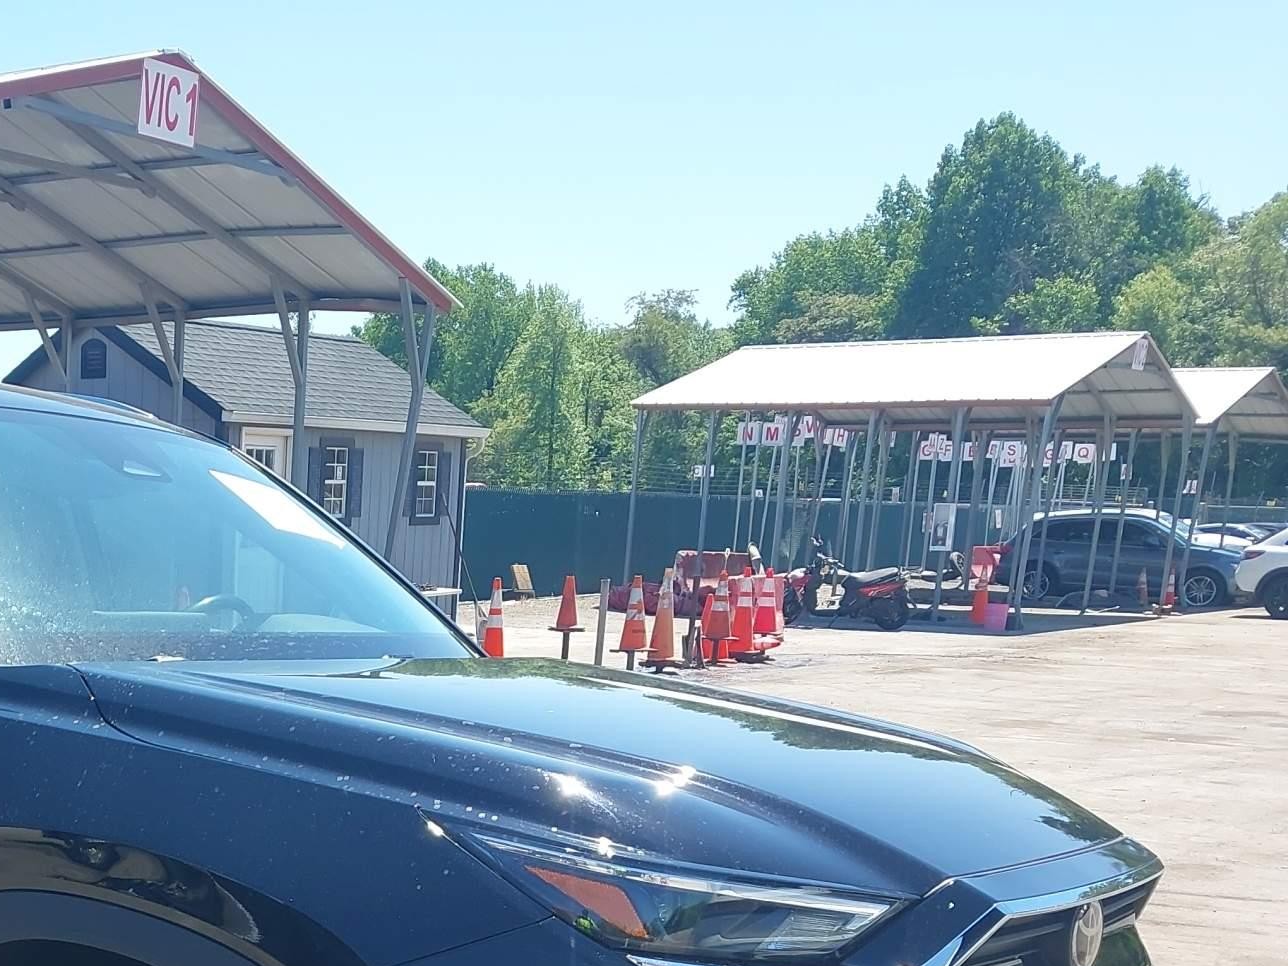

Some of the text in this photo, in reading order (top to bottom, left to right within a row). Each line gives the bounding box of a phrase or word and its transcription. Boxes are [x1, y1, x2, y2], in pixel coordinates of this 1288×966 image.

[144, 68, 197, 137] VIC 1
[742, 426, 754, 441] N
[766, 426, 779, 441] M
[1007, 444, 1017, 456] S
[1078, 447, 1090, 459] Q
